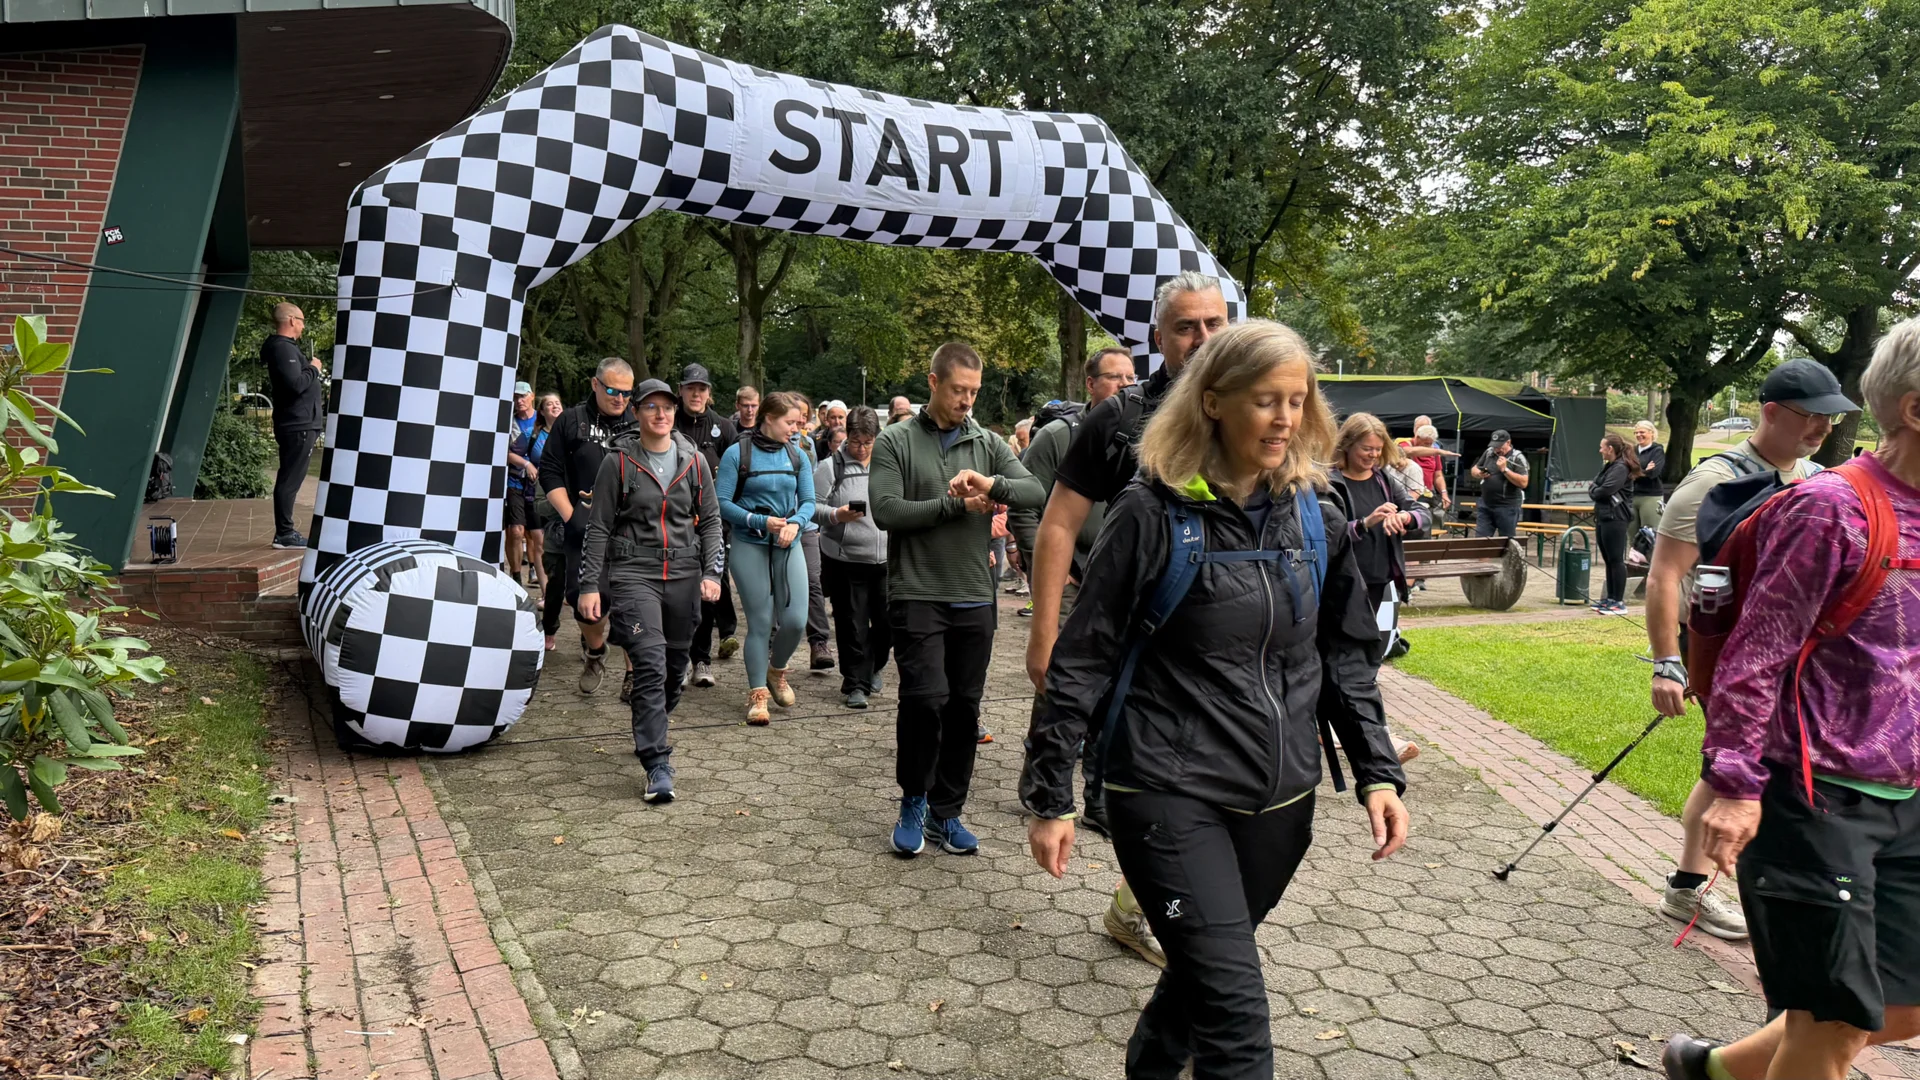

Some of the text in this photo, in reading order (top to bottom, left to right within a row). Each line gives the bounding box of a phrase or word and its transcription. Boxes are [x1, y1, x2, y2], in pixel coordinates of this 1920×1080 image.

[768, 99, 1013, 198] START
[105, 228, 121, 237] FCK
[107, 234, 123, 242] AFD
